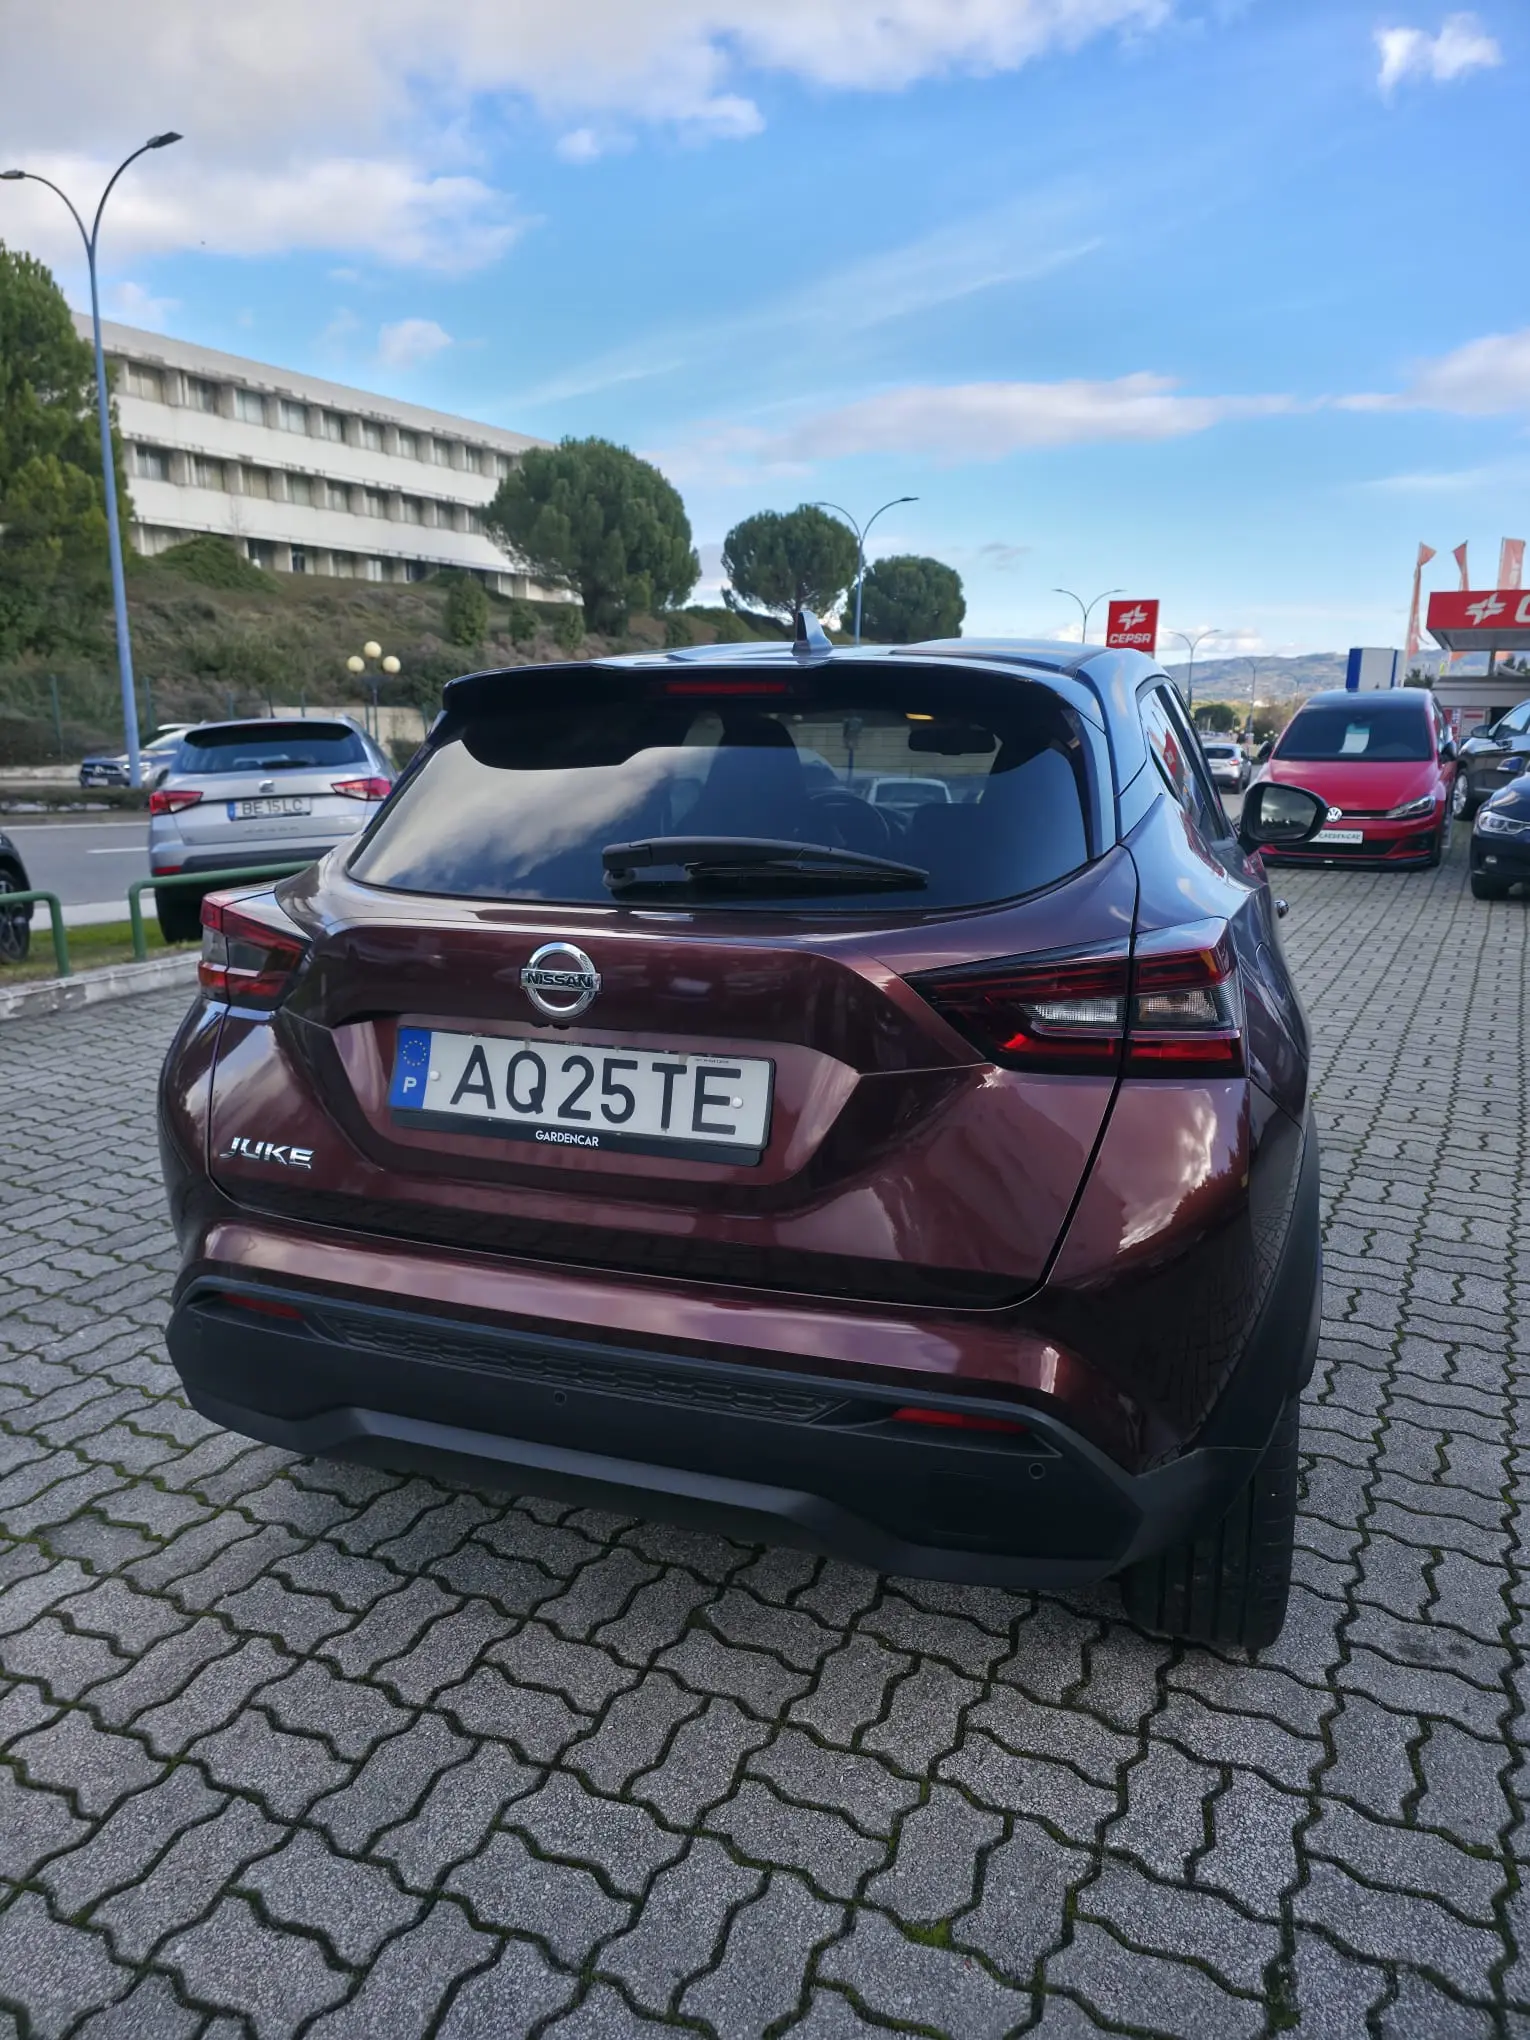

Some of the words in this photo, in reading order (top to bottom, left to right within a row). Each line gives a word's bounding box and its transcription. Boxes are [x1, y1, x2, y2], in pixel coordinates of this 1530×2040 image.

[1110, 633, 1151, 643] CEPSA
[527, 972, 593, 990] NISSAN
[403, 1076, 417, 1093] P
[535, 1130, 599, 1147] GARDENCAR
[219, 1136, 315, 1170] JUKE
